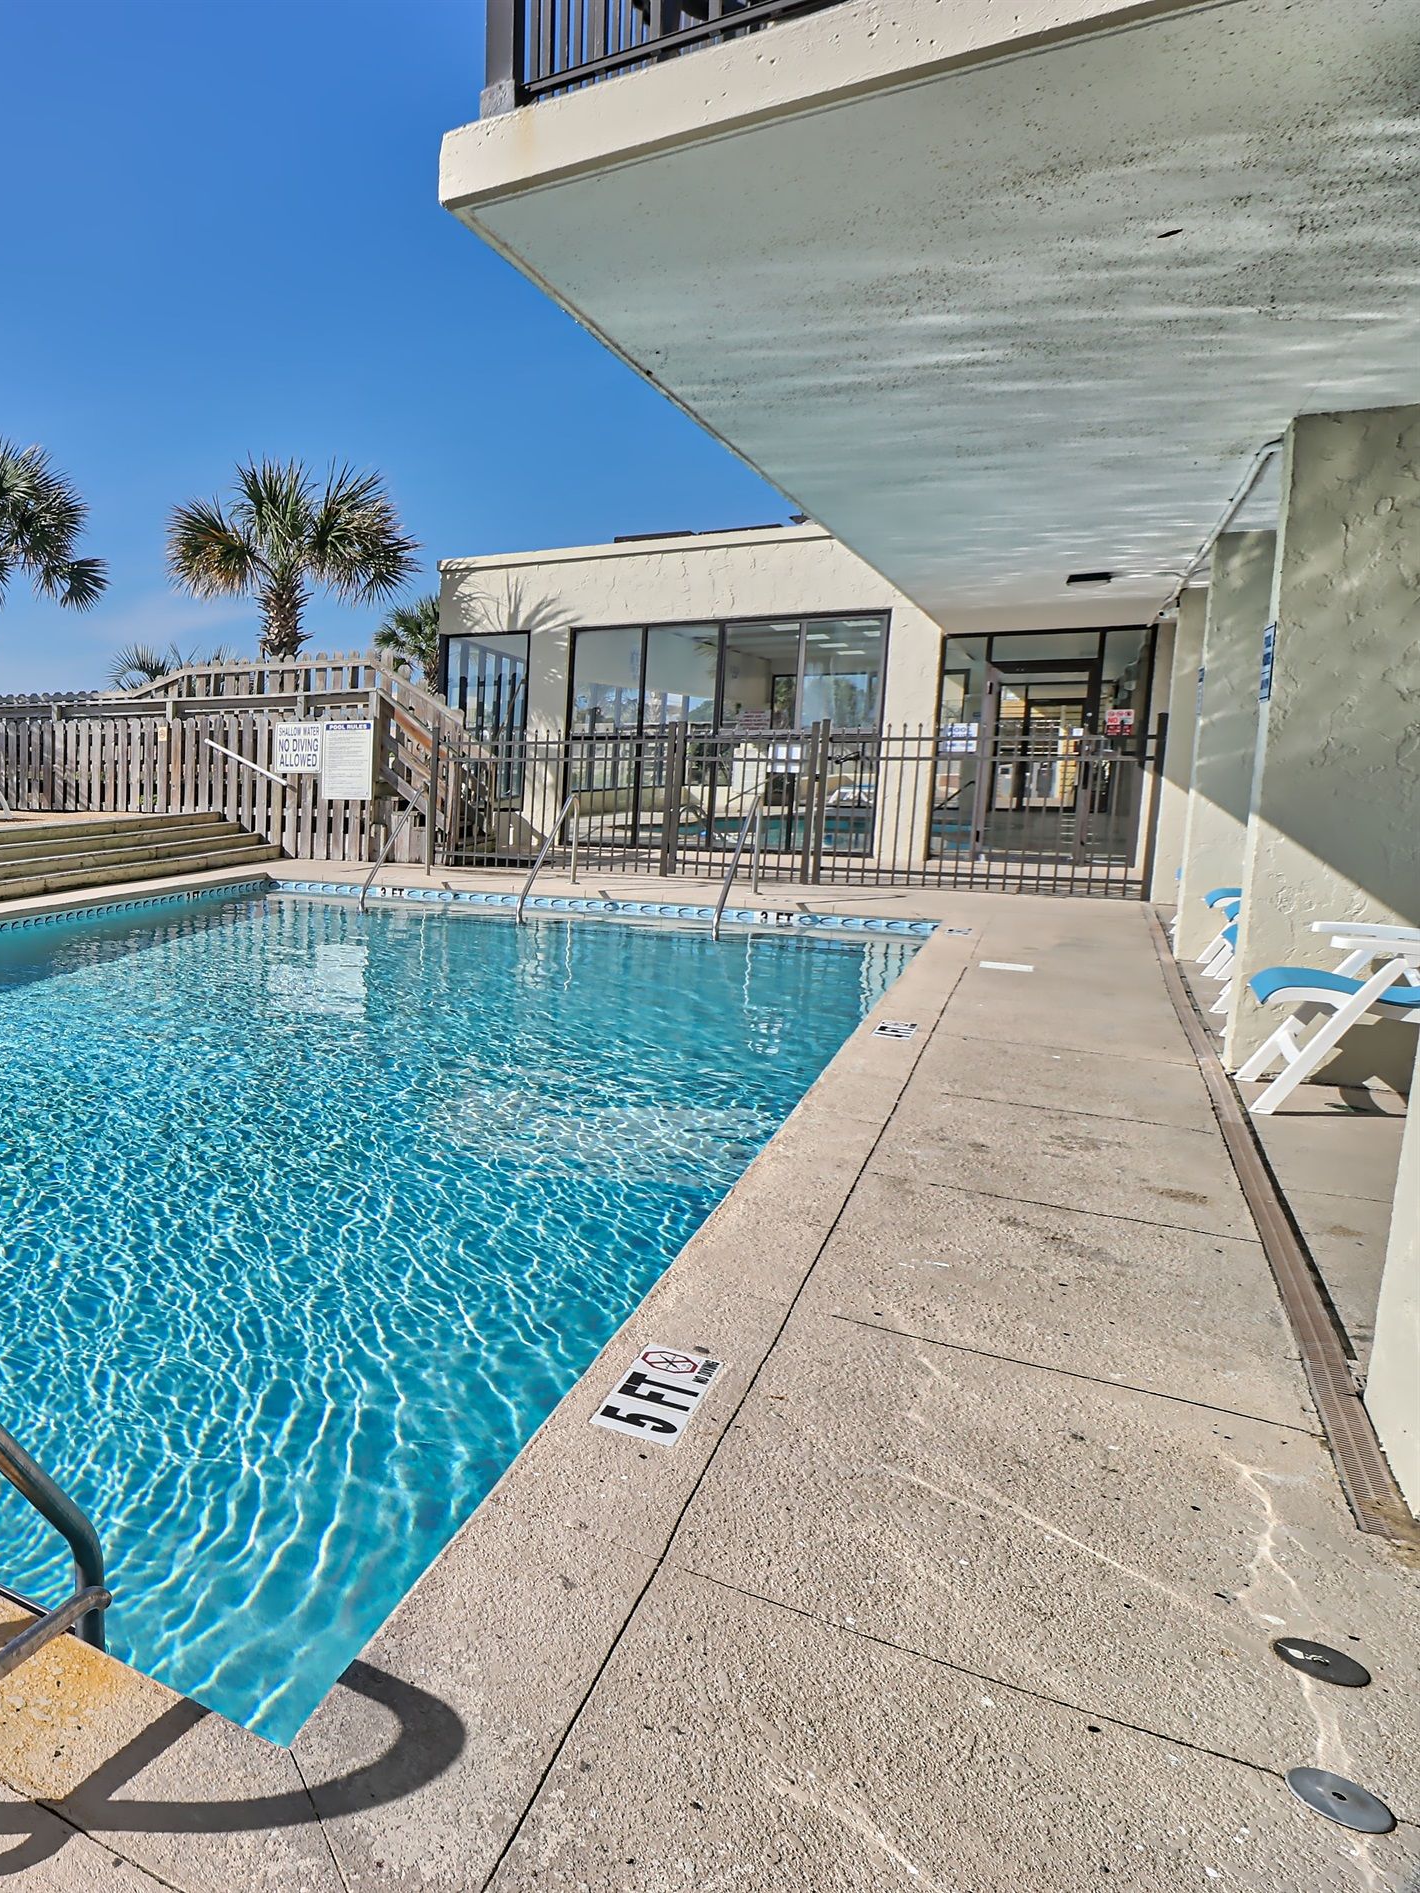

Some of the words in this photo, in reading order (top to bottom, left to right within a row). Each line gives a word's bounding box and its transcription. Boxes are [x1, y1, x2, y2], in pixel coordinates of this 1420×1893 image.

[279, 726, 301, 736] SHALLOW
[303, 726, 319, 736] WATER
[278, 738, 289, 752] NO
[292, 738, 319, 752] DIVING
[280, 753, 317, 767] ALLOWED
[381, 887, 386, 897] 3
[392, 888, 404, 896] FT
[776, 912, 793, 921] FT
[618, 1371, 699, 1412] FT
[600, 1404, 678, 1434] 5
